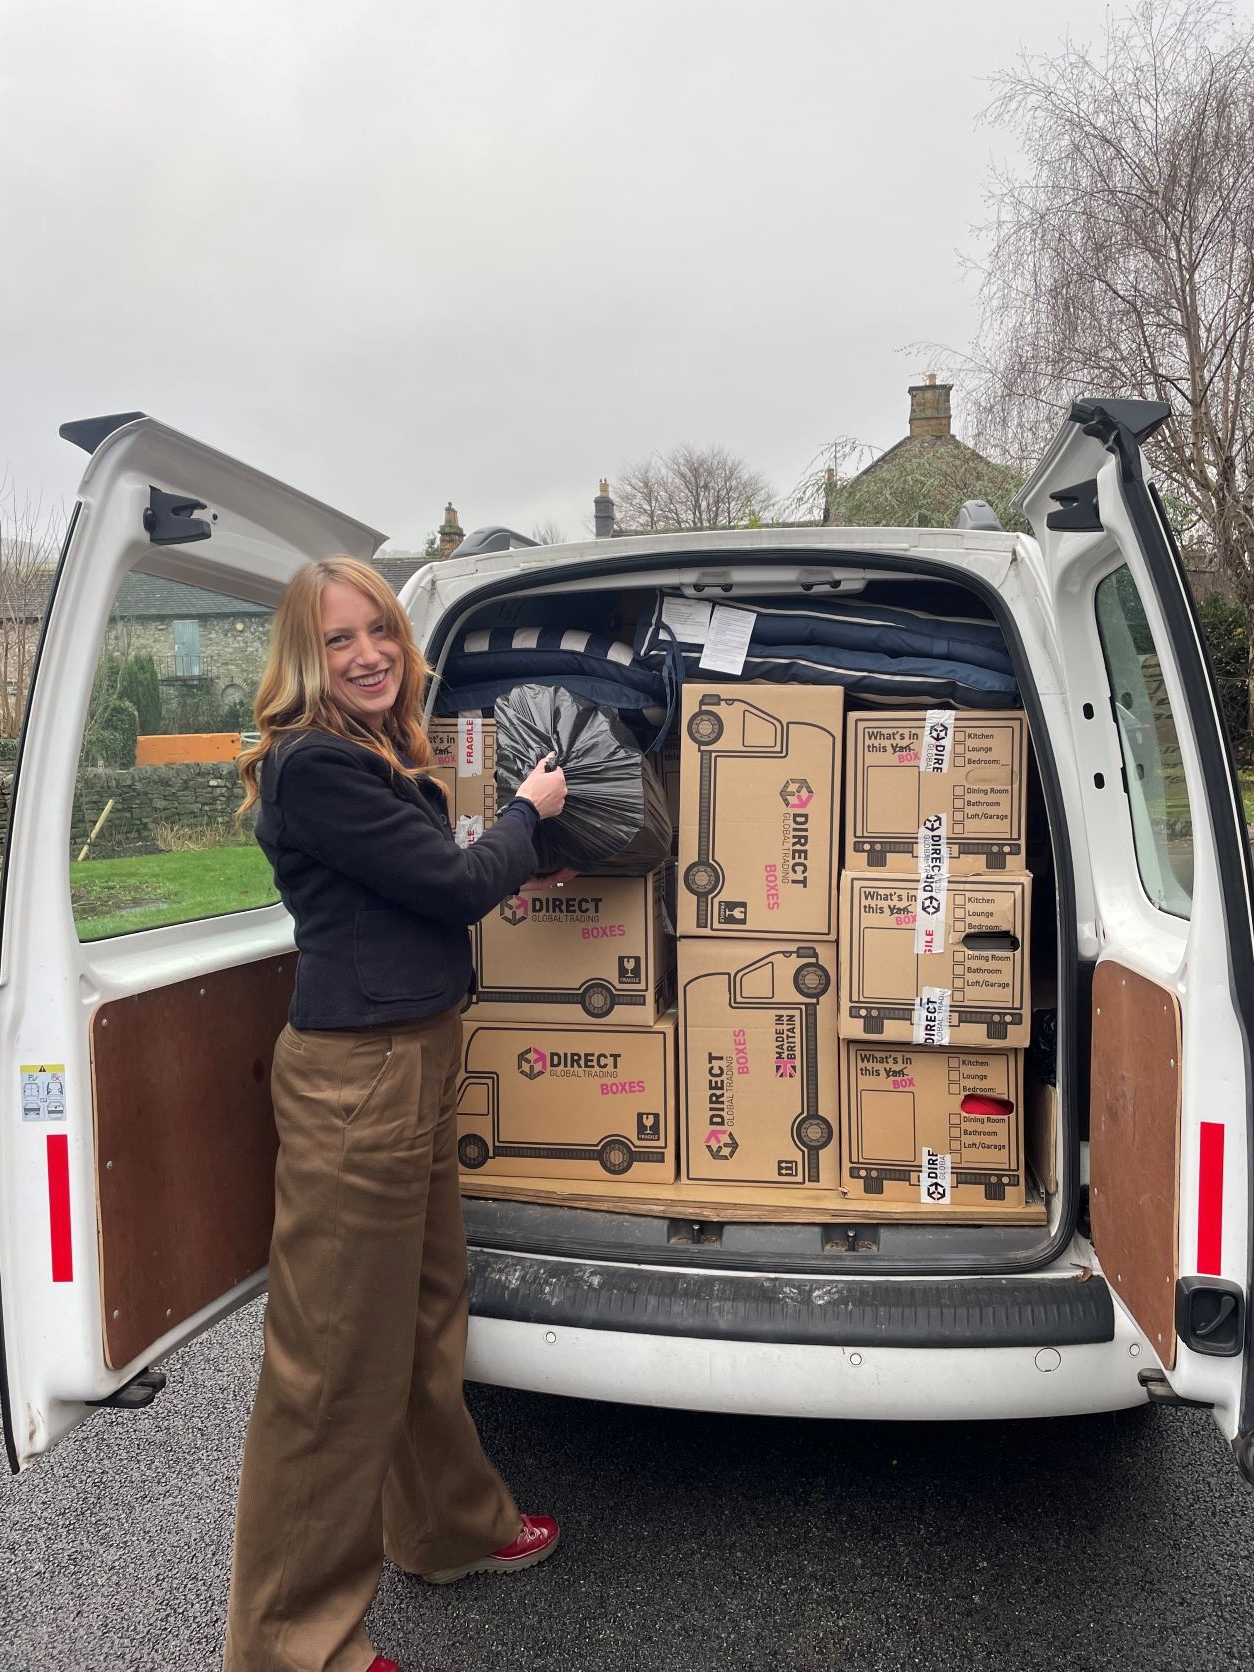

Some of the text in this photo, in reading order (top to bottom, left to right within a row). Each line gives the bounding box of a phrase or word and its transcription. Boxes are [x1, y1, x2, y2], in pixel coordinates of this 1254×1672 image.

[446, 735, 455, 744] in
[867, 730, 919, 741] What's in
[967, 732, 994, 740] Kitchen
[466, 719, 474, 764] FRAGILE
[867, 743, 888, 753] this
[967, 745, 993, 754] Lounge
[437, 754, 456, 766] BOX
[898, 751, 920, 764] BOX
[932, 744, 946, 773] DIRE
[967, 757, 1001, 766] Bedroom:
[966, 787, 1009, 796] Dining Room
[966, 800, 1001, 808] Bathroom
[966, 812, 1009, 820] Loft/Garage
[781, 812, 791, 885] GLOBAL TRADING
[790, 812, 809, 889] DIRECT
[931, 834, 942, 873] DIREC
[764, 863, 780, 911] BOXES
[863, 890, 917, 902] What's in
[967, 897, 996, 905] Kitchen
[531, 897, 603, 914] DIRECT
[863, 904, 885, 914] this
[531, 914, 600, 923] GLOBAL TRADING
[895, 914, 917, 926] BOX
[967, 910, 994, 919] Lounge
[581, 924, 627, 940] BOXES
[967, 923, 1003, 931] Bedroom:
[923, 929, 935, 955] GILE
[966, 954, 1011, 963] Dining Room
[966, 967, 1003, 975] Bathroom
[966, 980, 1010, 989] Loft/Garage
[774, 1014, 785, 1060] MADE IN
[786, 1014, 797, 1060] BRITAIN
[733, 1028, 750, 1075] BOXES
[549, 1051, 622, 1069] DIRECT
[859, 1053, 912, 1065] What's in
[961, 1059, 989, 1067] Kitchen
[549, 1069, 618, 1079] GLOBAL TRADING
[859, 1066, 881, 1077] this
[962, 1073, 988, 1081] Lounge
[600, 1080, 646, 1096] BOXES
[892, 1077, 916, 1089] BOX
[708, 1051, 726, 1127] DIRECT
[725, 1055, 735, 1127] GLOBAL TRADING
[962, 1085, 997, 1094] Bedroom:
[963, 1116, 985, 1124] Dining
[963, 1129, 998, 1137] Bathroom
[963, 1141, 1006, 1150] Loft/Garage
[927, 1149, 939, 1180] DIRE
